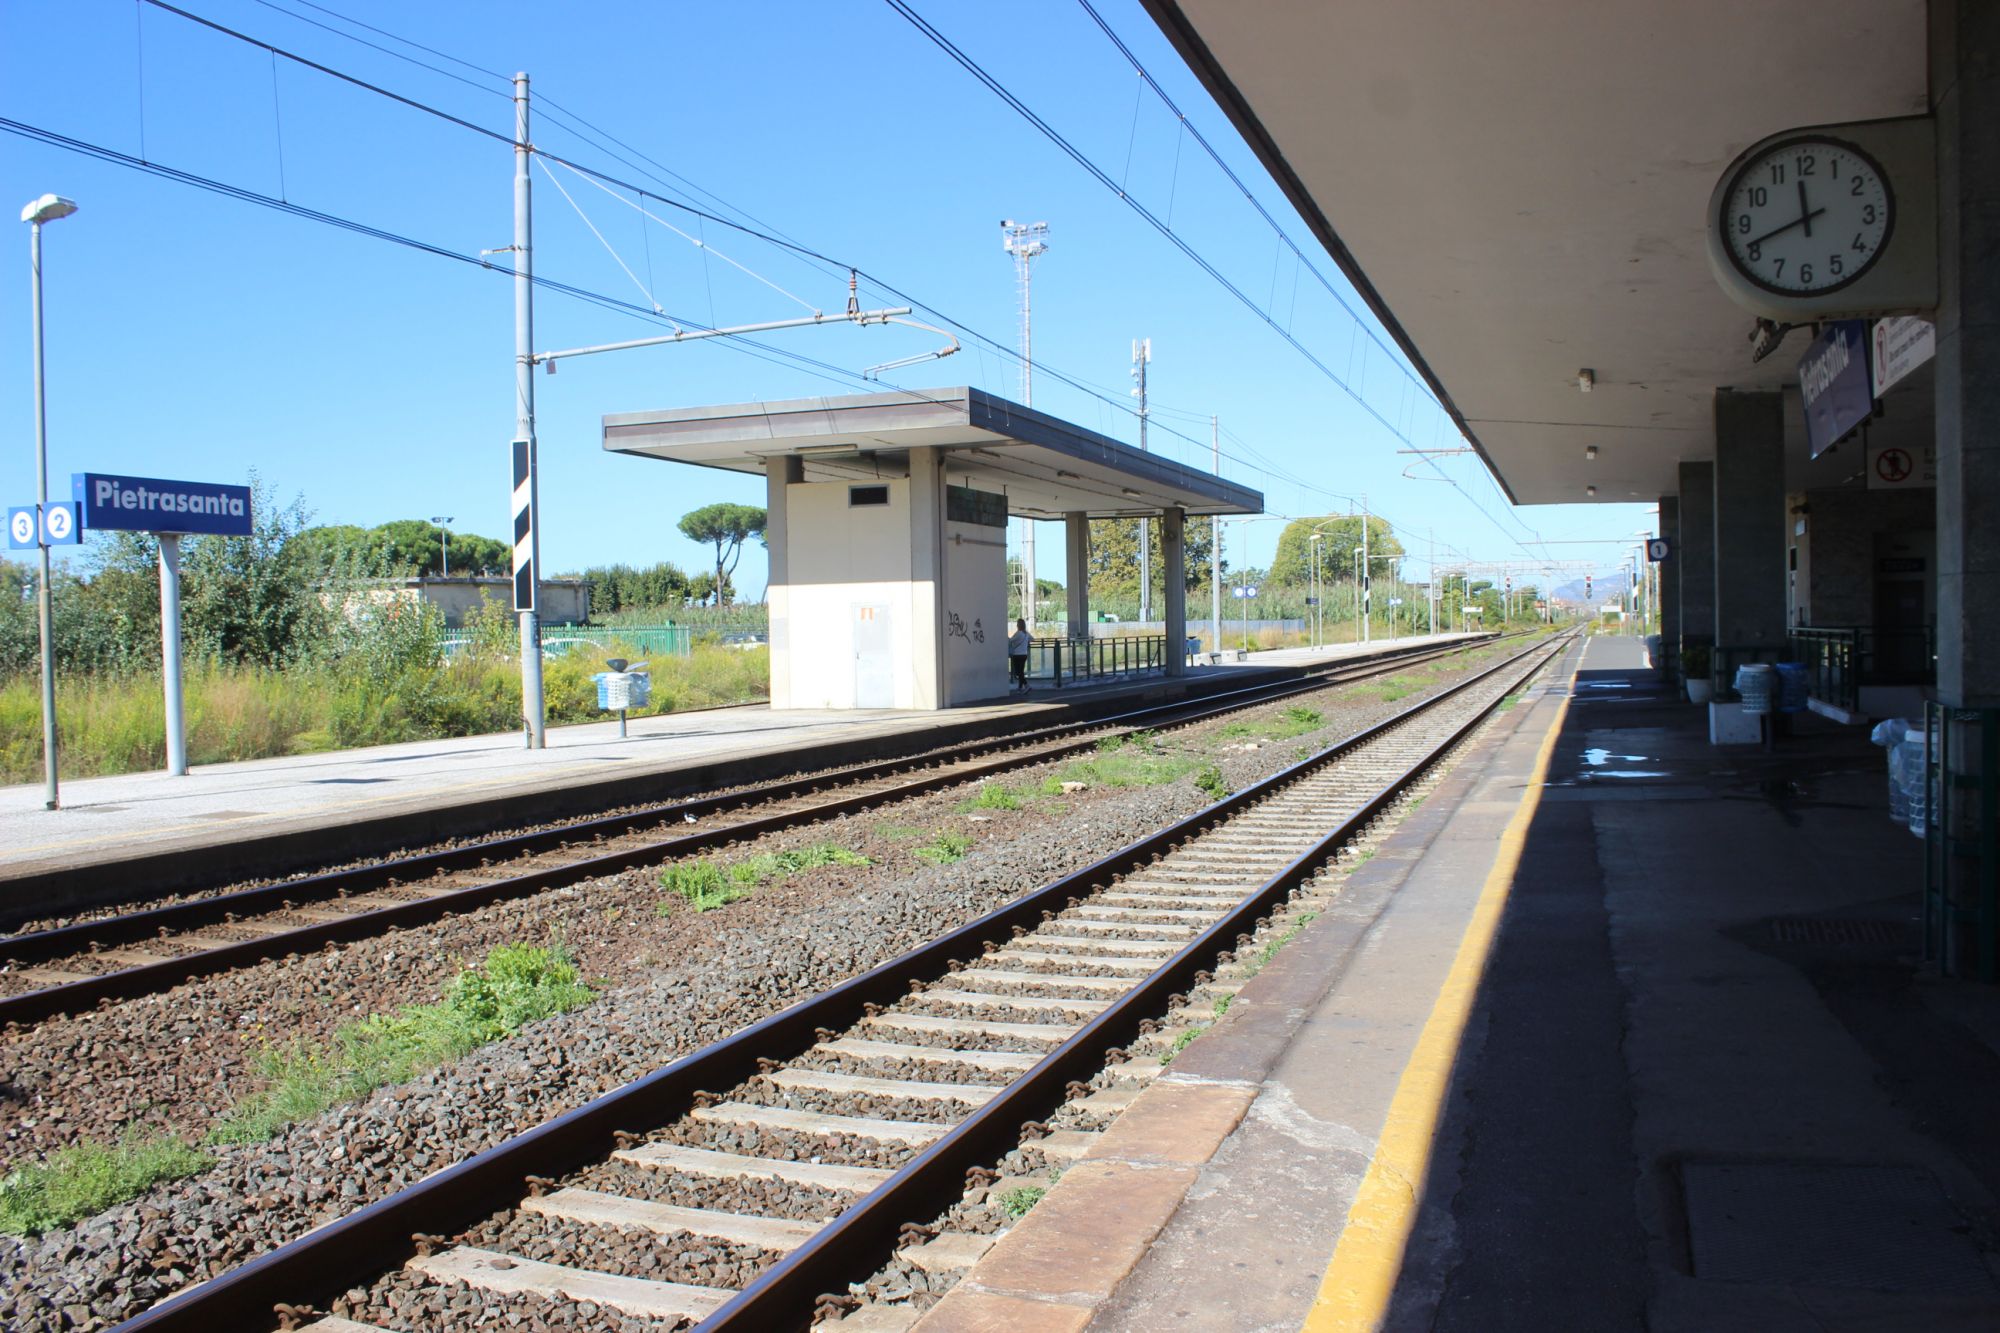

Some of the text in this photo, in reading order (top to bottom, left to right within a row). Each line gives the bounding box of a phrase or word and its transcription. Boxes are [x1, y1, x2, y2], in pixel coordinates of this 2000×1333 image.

[1770, 163, 1785, 185] 11
[1796, 155, 1815, 176] 12
[1830, 159, 1838, 180] 1
[1851, 175, 1864, 196] 2
[1747, 186, 1768, 208] 10
[1738, 214, 1751, 234] 9
[1862, 204, 1876, 225] 3
[1748, 241, 1762, 262] 8
[1851, 232, 1867, 253] 4
[1773, 258, 1786, 279] 7
[1800, 263, 1814, 284] 6
[1829, 254, 1843, 275] 5
[94, 479, 245, 517] Pietrasanta
[18, 518, 28, 537] 3
[53, 513, 65, 532] 2
